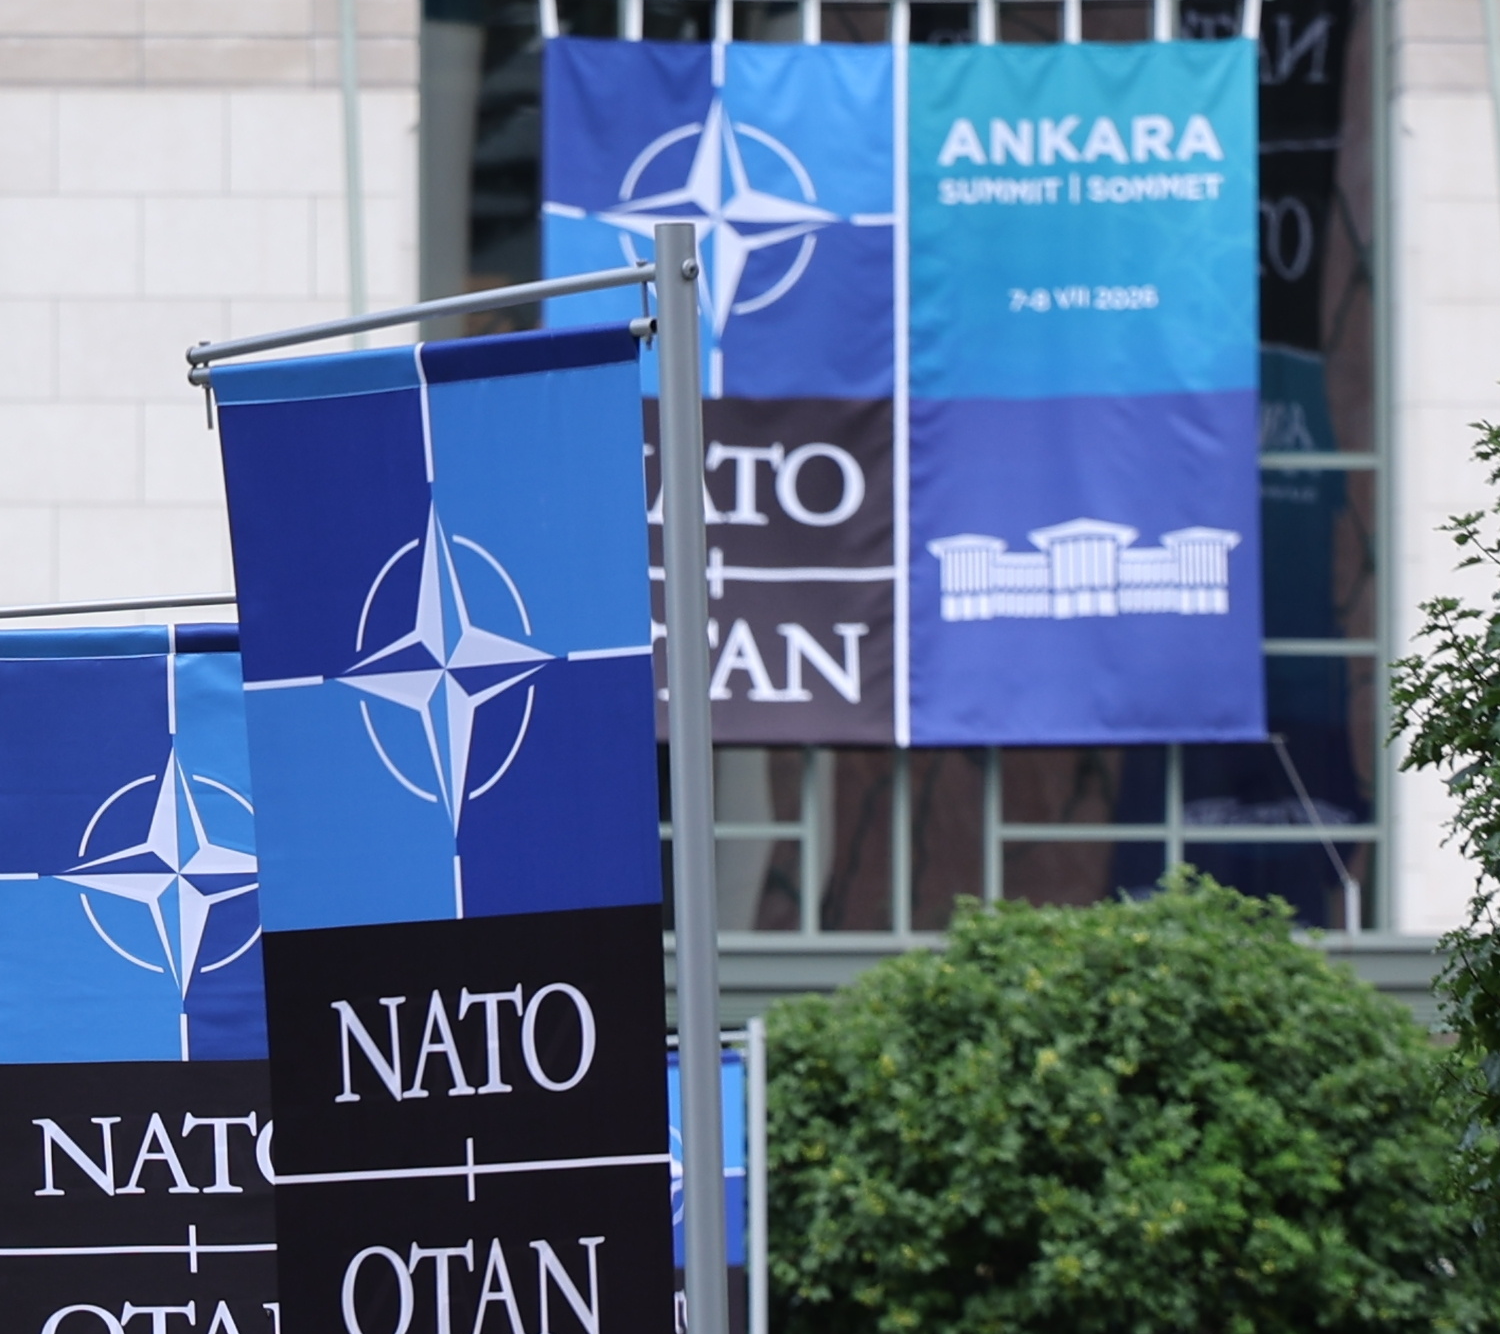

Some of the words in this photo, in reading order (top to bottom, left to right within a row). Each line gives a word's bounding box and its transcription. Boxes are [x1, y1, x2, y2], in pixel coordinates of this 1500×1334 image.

[939, 115, 1224, 165] ANKARA
[940, 177, 1062, 205] SUMMIT
[1088, 173, 1224, 203] SOMMET
[647, 441, 865, 527] TO
[652, 618, 869, 704] AN
[331, 983, 595, 1102] NATO
[32, 1111, 275, 1196] NAT
